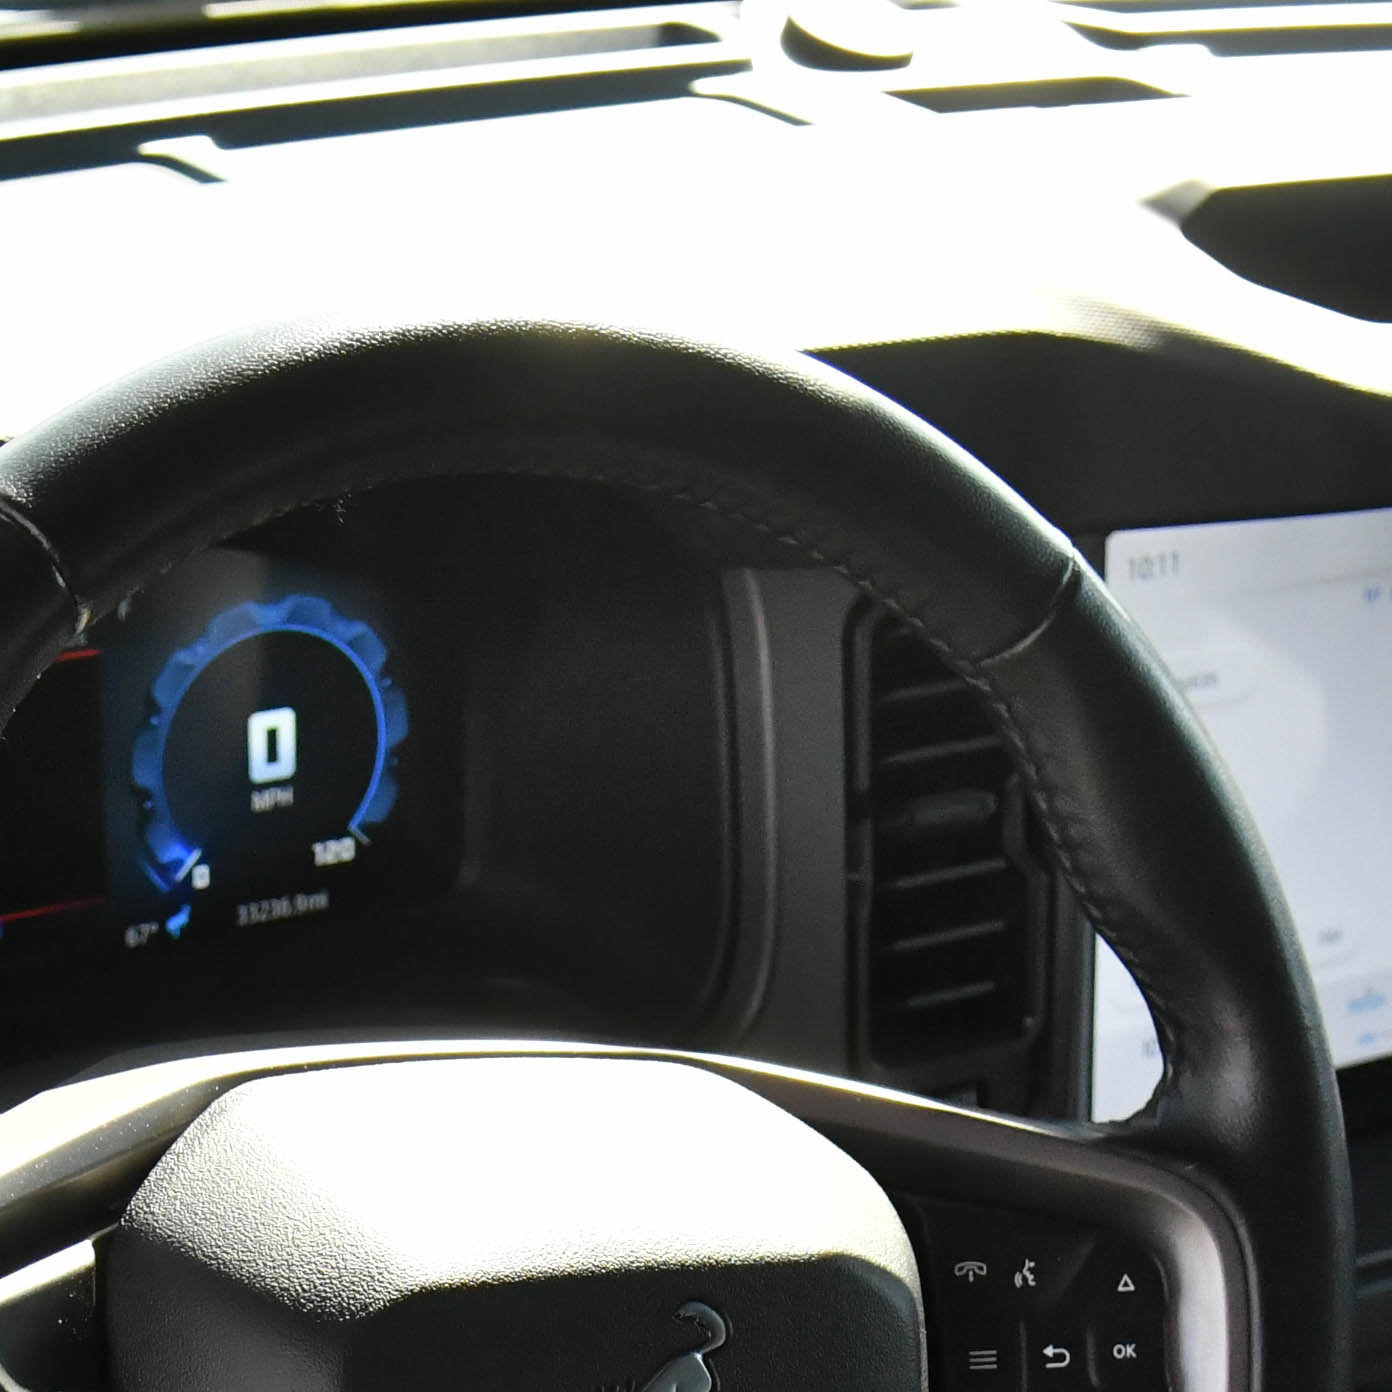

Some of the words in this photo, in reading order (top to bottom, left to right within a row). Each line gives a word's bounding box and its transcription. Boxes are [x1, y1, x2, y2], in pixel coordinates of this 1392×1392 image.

[247, 706, 297, 785] 0
[250, 785, 295, 812] MPH
[191, 863, 210, 890] 0
[1112, 1343, 1137, 1359] OK
